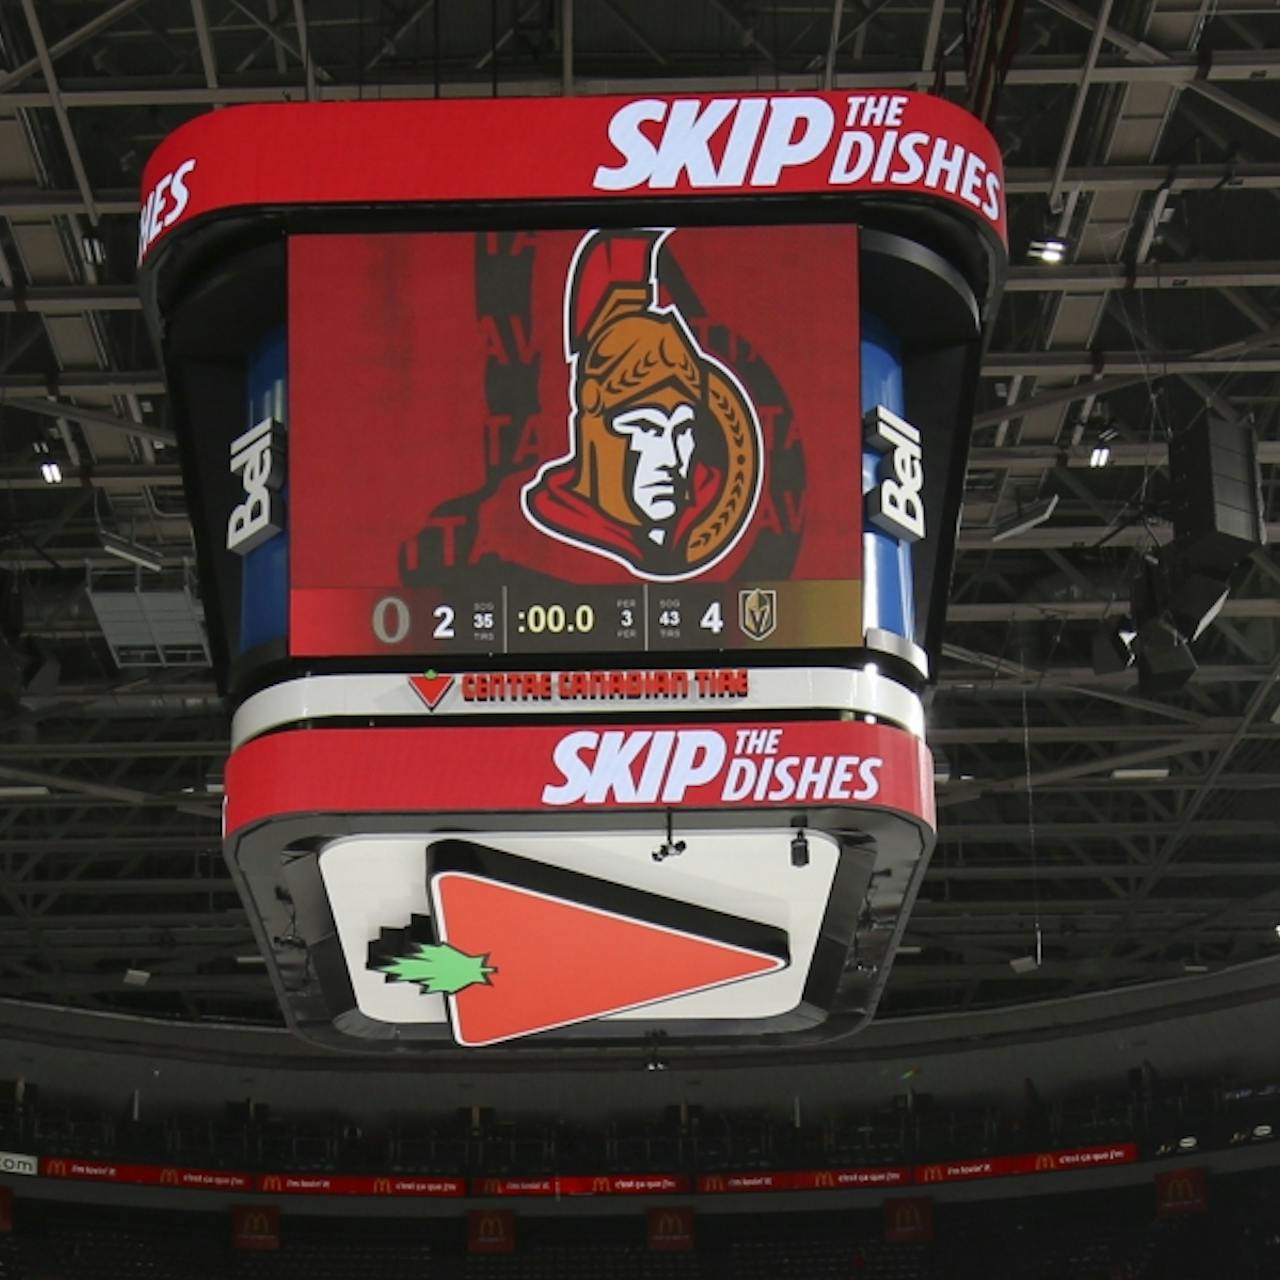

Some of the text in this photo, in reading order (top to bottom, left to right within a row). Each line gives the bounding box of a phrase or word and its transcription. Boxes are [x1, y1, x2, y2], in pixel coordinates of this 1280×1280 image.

[846, 96, 908, 128] THE
[593, 96, 835, 190] SKIP
[829, 129, 1000, 221] DISHES
[227, 416, 273, 550] Bell
[877, 404, 925, 539] Bell
[433, 605, 455, 638] 2
[474, 613, 494, 629] 35
[621, 610, 633, 627] 3
[659, 611, 680, 626] 43
[700, 602, 723, 633] 4
[462, 669, 749, 701] CENTRE CANADIAN TIRE
[541, 729, 726, 805] SKIP
[736, 729, 783, 757] THE
[724, 756, 883, 802] DISHES
